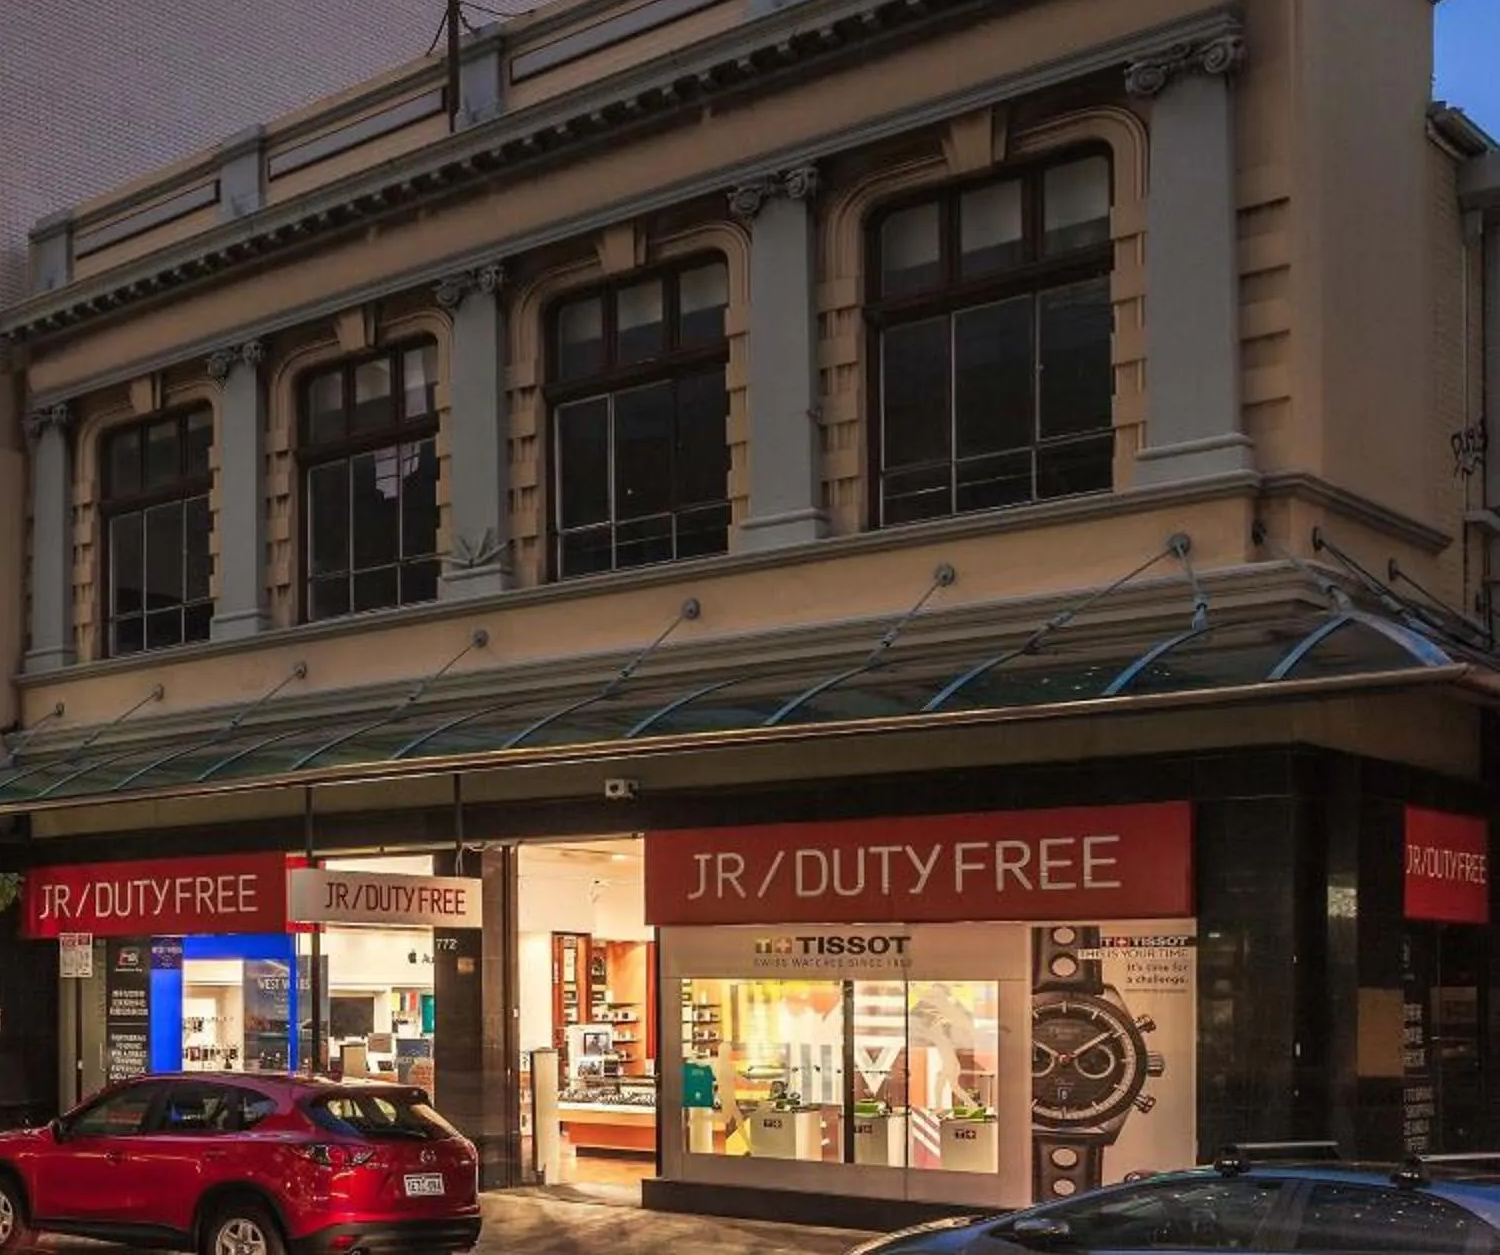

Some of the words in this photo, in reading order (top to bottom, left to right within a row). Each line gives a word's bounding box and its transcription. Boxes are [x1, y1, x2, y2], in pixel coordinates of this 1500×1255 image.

[435, 938, 458, 950] 772
[795, 936, 912, 954] TISSOT
[1131, 936, 1189, 946] TISSOT
